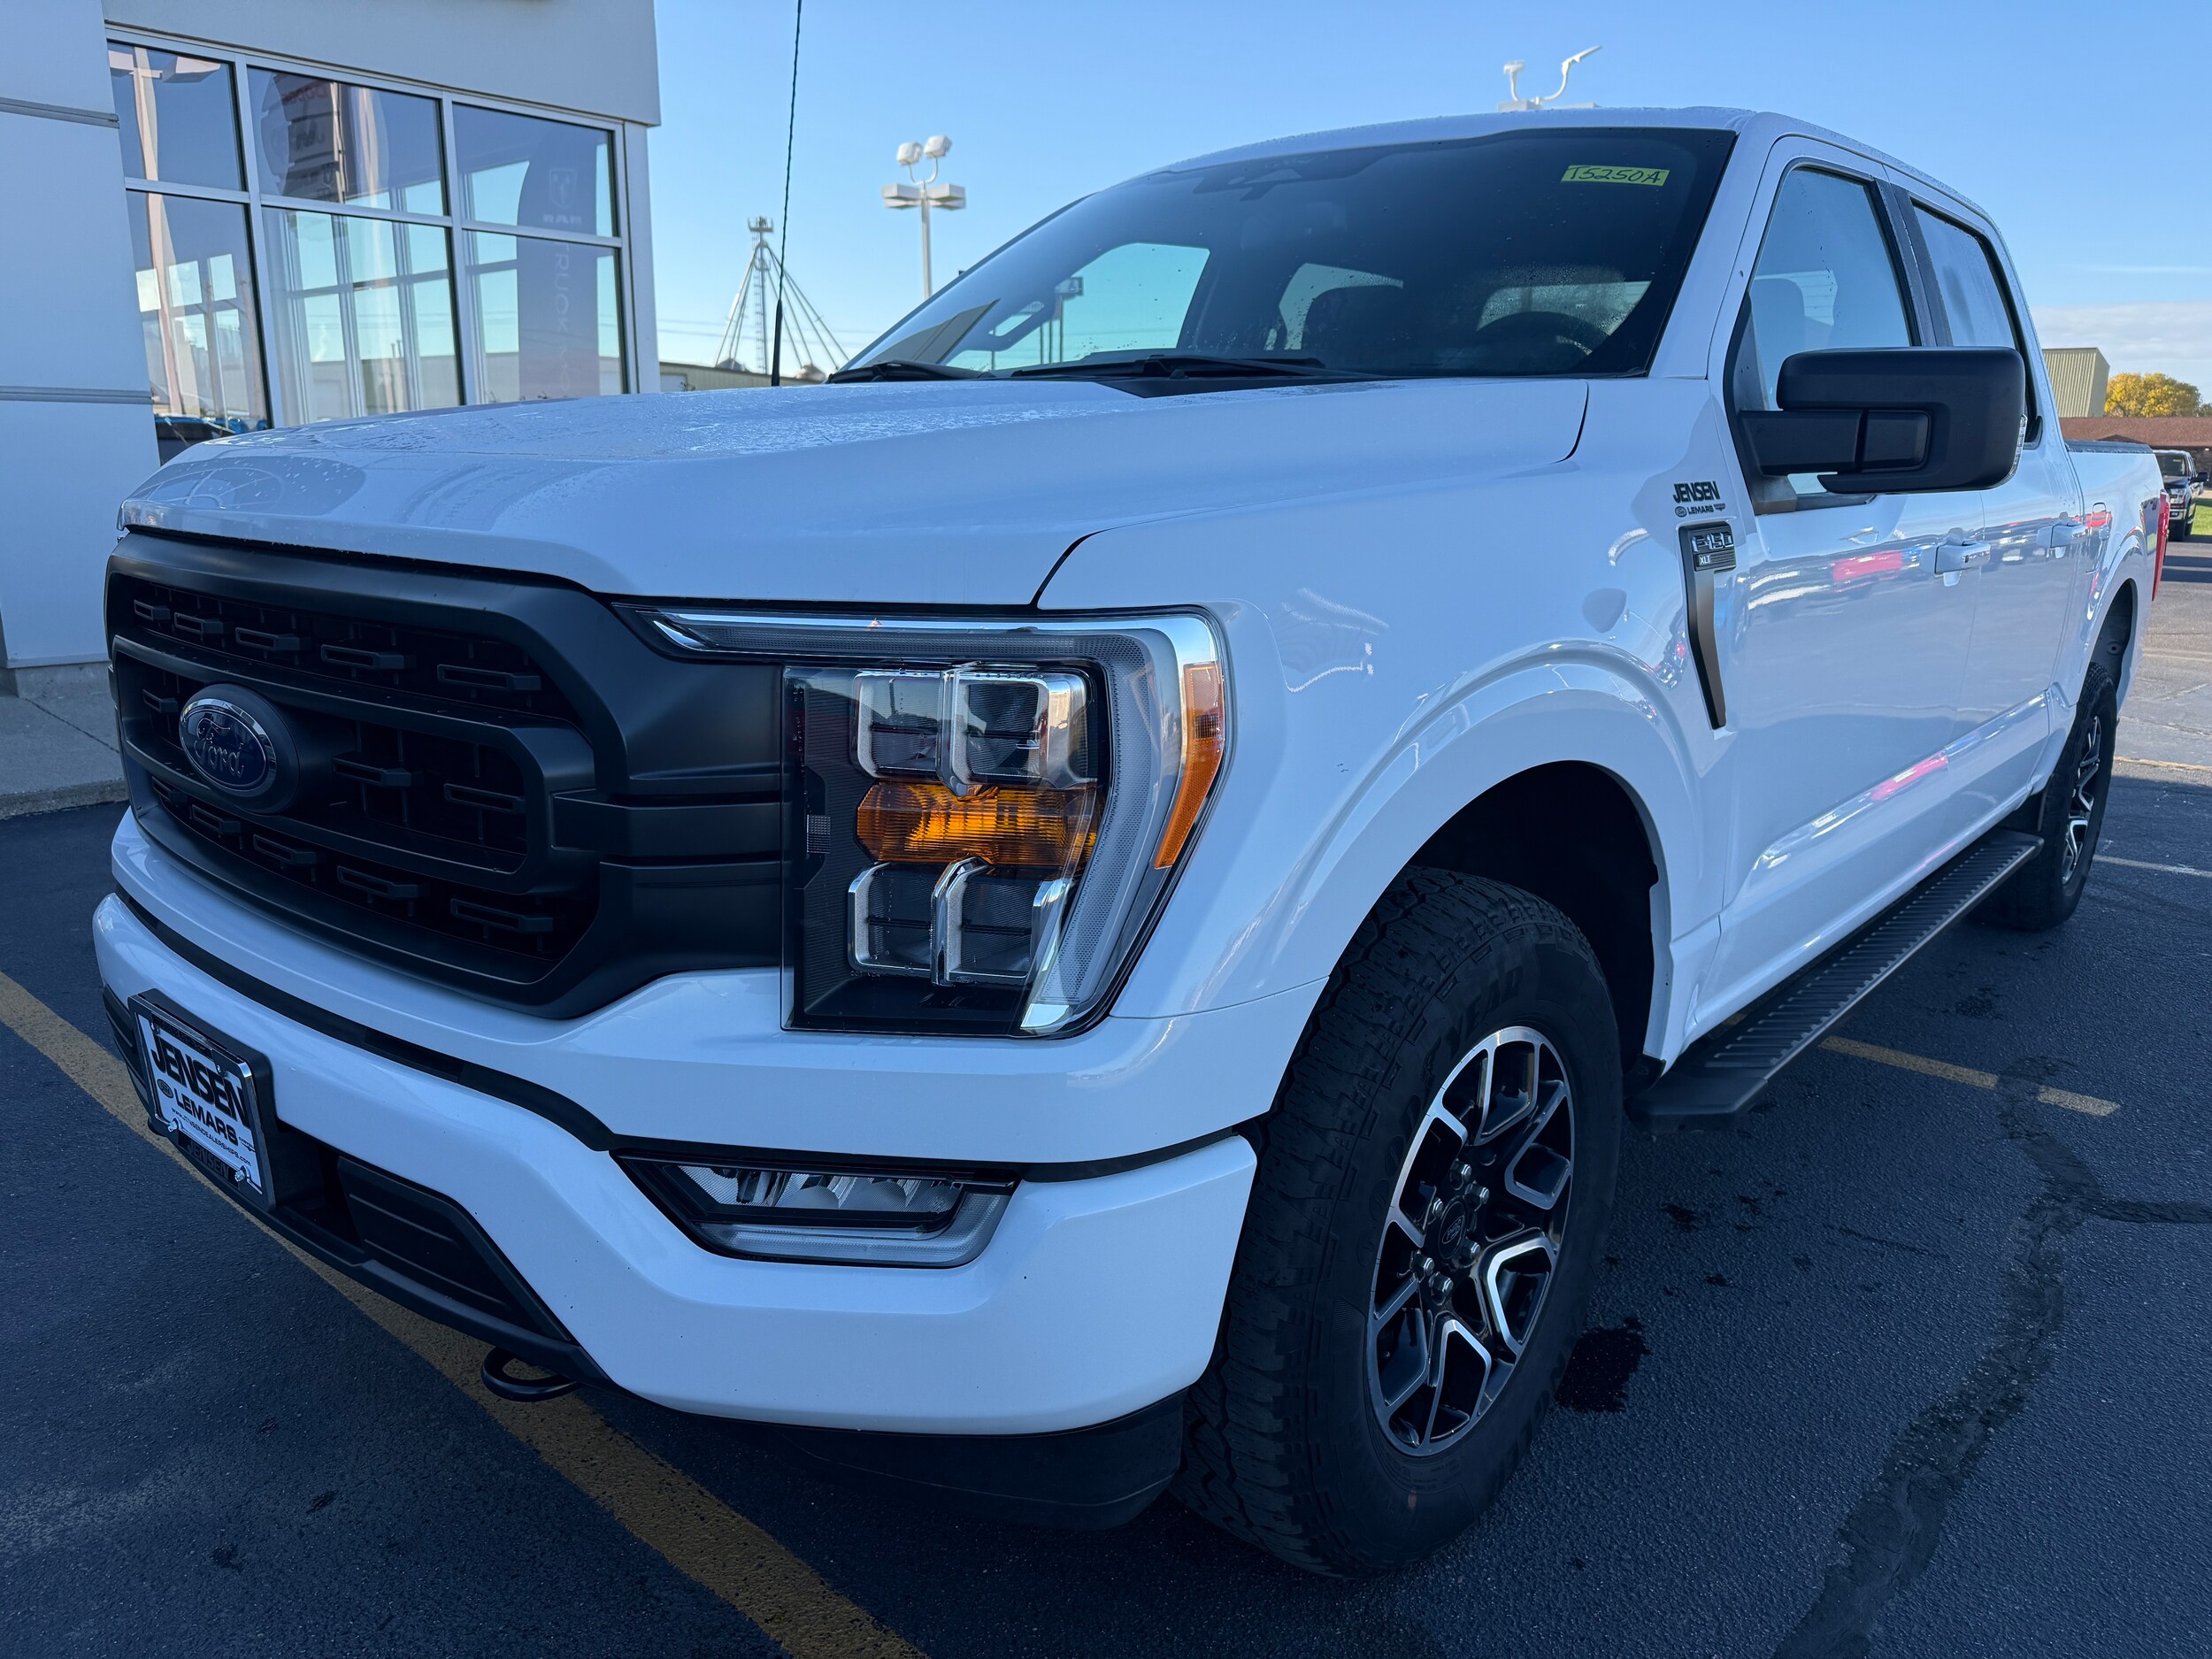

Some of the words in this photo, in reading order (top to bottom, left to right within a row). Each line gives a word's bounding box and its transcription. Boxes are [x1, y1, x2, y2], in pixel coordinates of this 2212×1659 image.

[1672, 480, 1720, 503] JENSEN
[1686, 505, 1715, 515] LEMARS
[1692, 532, 1734, 552] F-150
[1699, 555, 1711, 565] XLT
[193, 718, 244, 778] Ford
[150, 1040, 250, 1129] JENSEN
[173, 1087, 239, 1146] LEMARS
[187, 1140, 229, 1180] JENSEN
